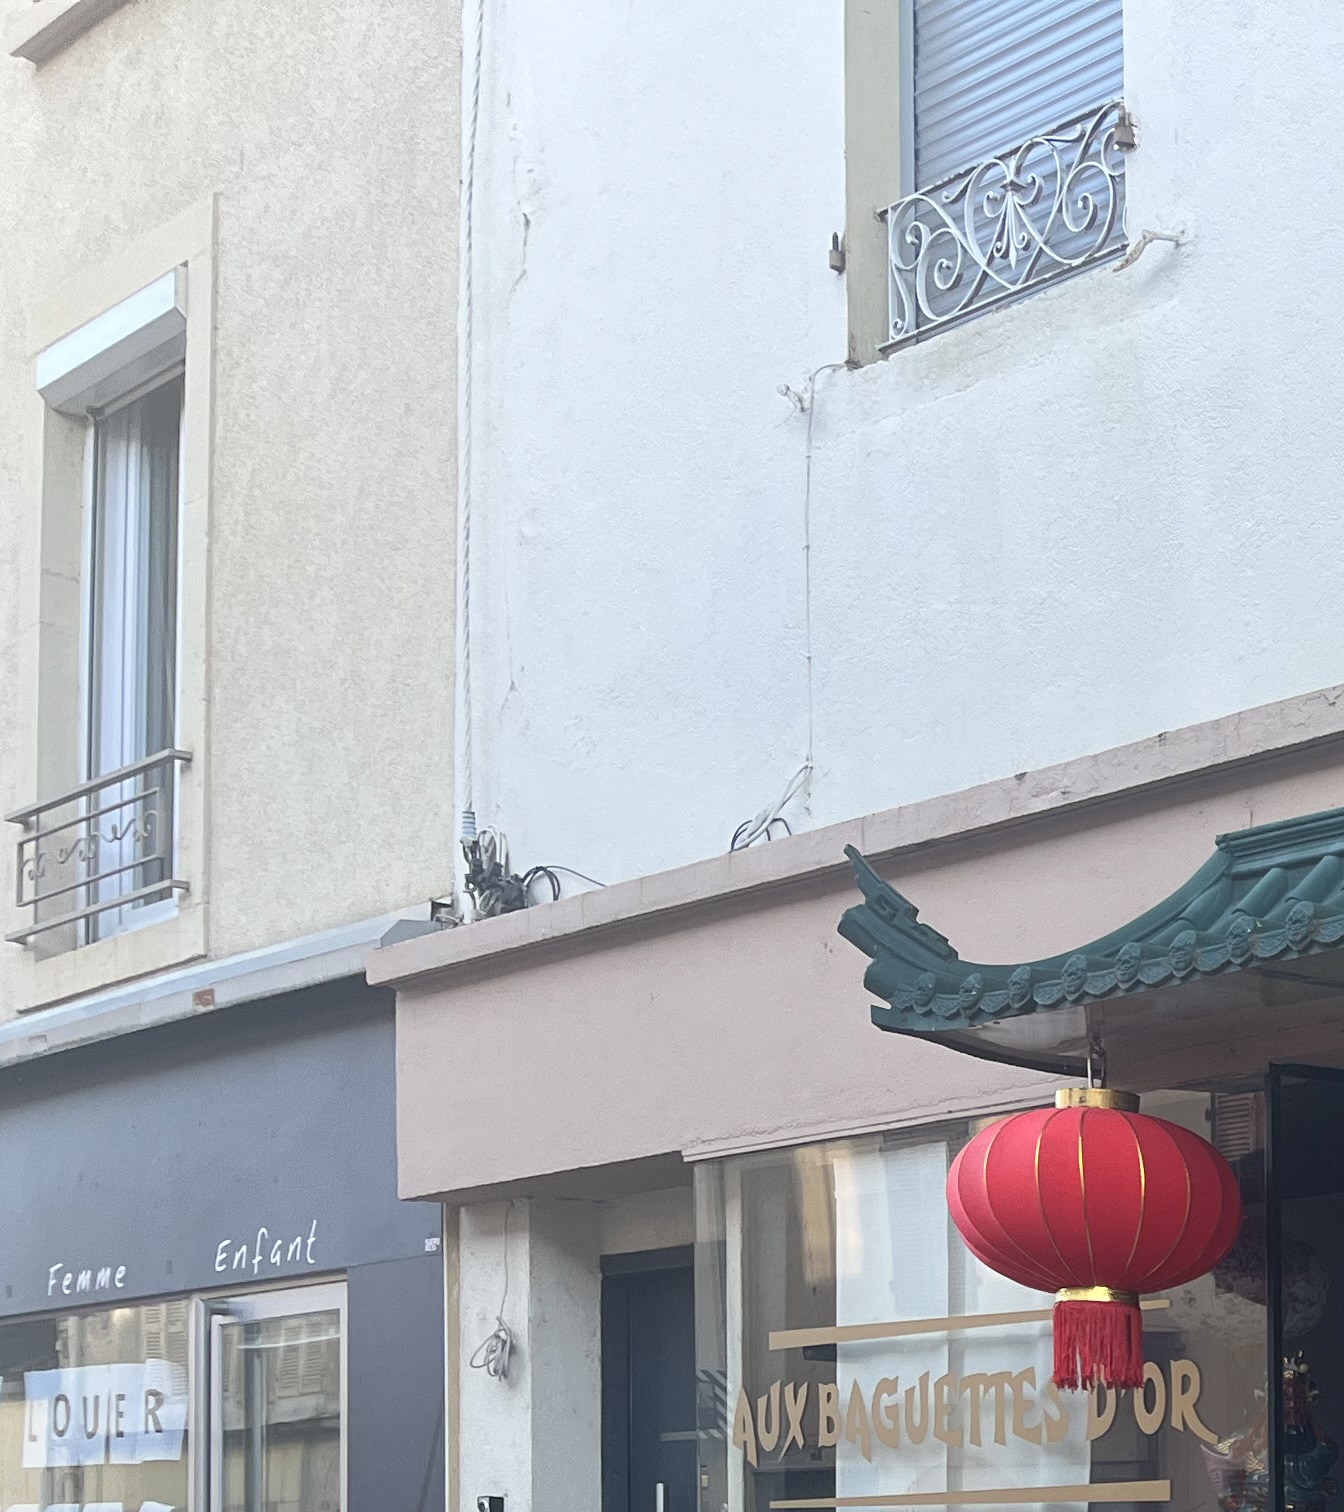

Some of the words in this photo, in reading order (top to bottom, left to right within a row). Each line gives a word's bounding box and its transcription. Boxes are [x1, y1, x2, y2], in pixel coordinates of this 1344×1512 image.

[214, 1219, 317, 1275] Enfant
[48, 1263, 127, 1296] Femme
[732, 1380, 809, 1469] AUX
[817, 1367, 1069, 1464] BAGUETTES
[1086, 1359, 1219, 1445] DOR
